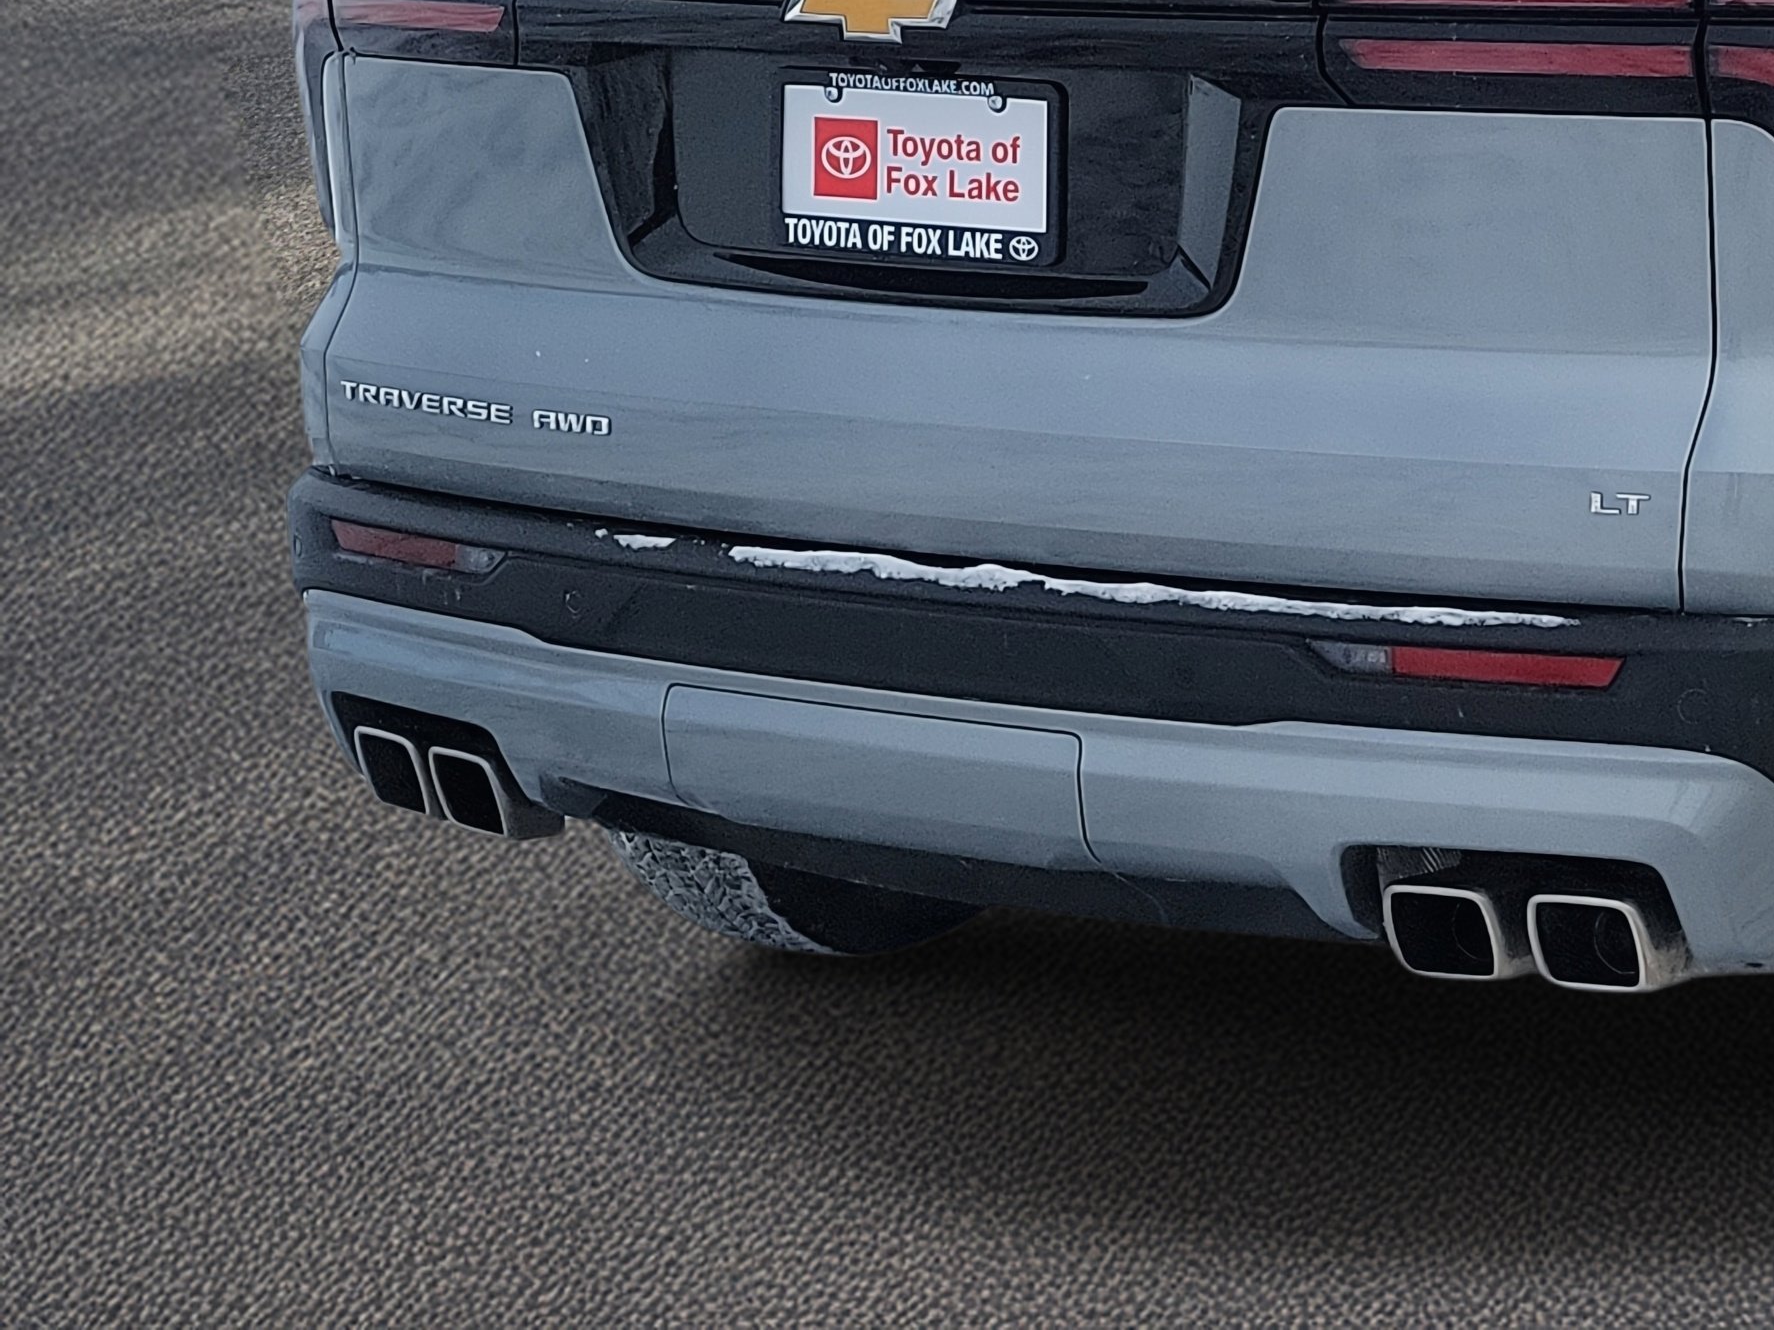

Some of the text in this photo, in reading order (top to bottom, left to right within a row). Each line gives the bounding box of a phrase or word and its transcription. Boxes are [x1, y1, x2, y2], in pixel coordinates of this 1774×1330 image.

[886, 128, 1021, 166] Toyota of
[886, 165, 1020, 202] Fox Lake
[784, 217, 1003, 259] TOYOTA OF FOX LAKE
[340, 380, 612, 436] TRAVERSE AWD
[1590, 491, 1651, 515] LT
